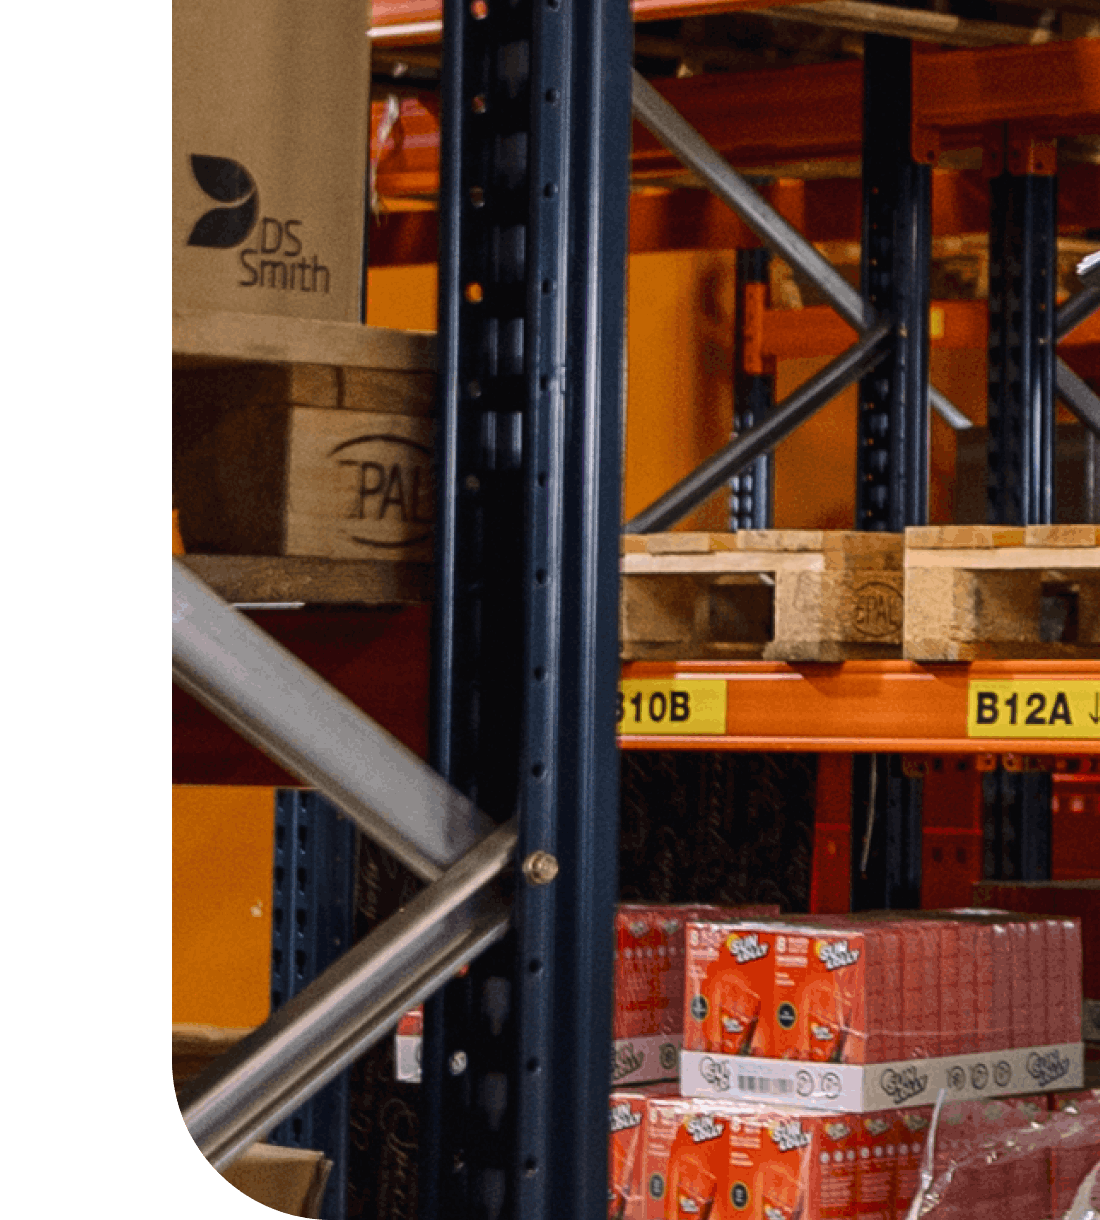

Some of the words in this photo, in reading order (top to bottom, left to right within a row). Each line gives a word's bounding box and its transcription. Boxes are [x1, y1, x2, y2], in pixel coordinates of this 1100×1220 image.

[260, 216, 302, 257] DS
[239, 248, 330, 294] Smith
[975, 691, 1073, 725] B12A
